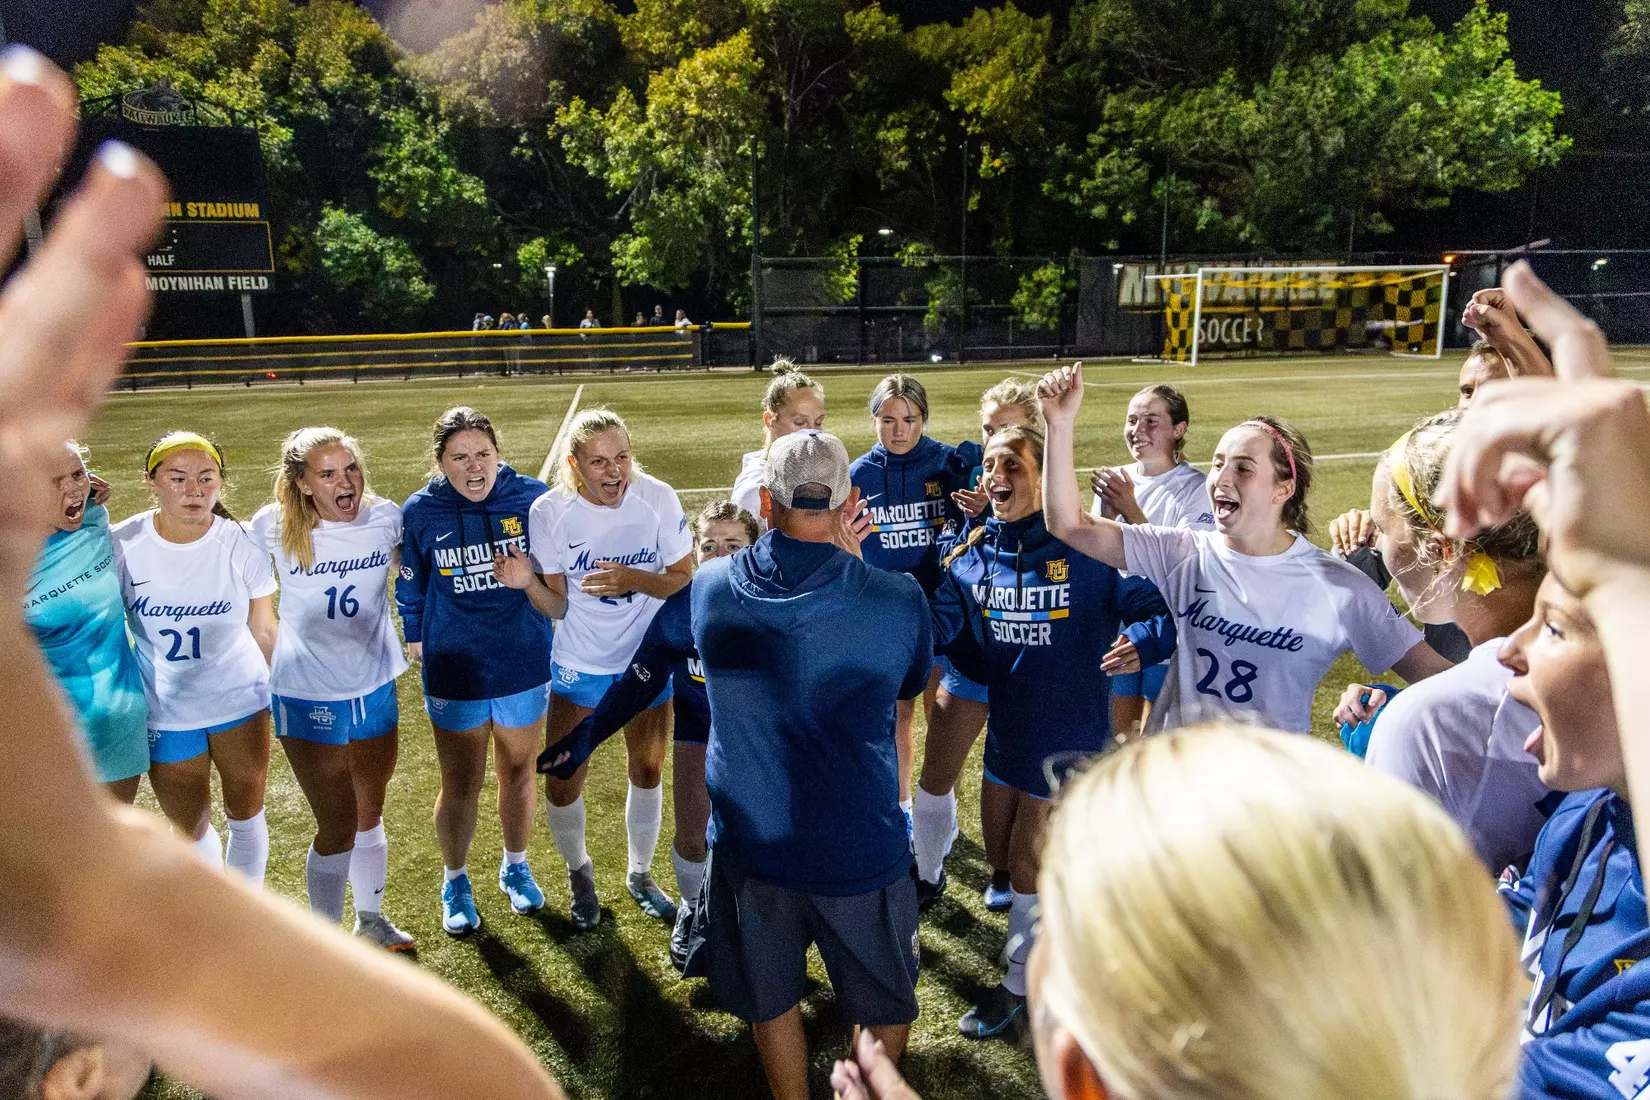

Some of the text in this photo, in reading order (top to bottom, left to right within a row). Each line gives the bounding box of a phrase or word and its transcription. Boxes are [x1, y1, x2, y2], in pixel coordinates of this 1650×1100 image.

[186, 203, 260, 217] STADIUM
[147, 254, 175, 266] HALF
[145, 276, 269, 290] MOYNIHAN FIELD
[500, 515, 523, 536] MU
[880, 527, 935, 549] SOCCER
[453, 570, 506, 594] SOCC
[1045, 558, 1070, 583] MU
[128, 595, 232, 622] Marquette
[324, 584, 360, 620] 16
[971, 583, 1071, 611] MARQUETTE
[990, 620, 1052, 646] SOCCER
[1177, 597, 1304, 652] Marquette
[158, 626, 201, 662] 21
[1195, 647, 1259, 703] 28
